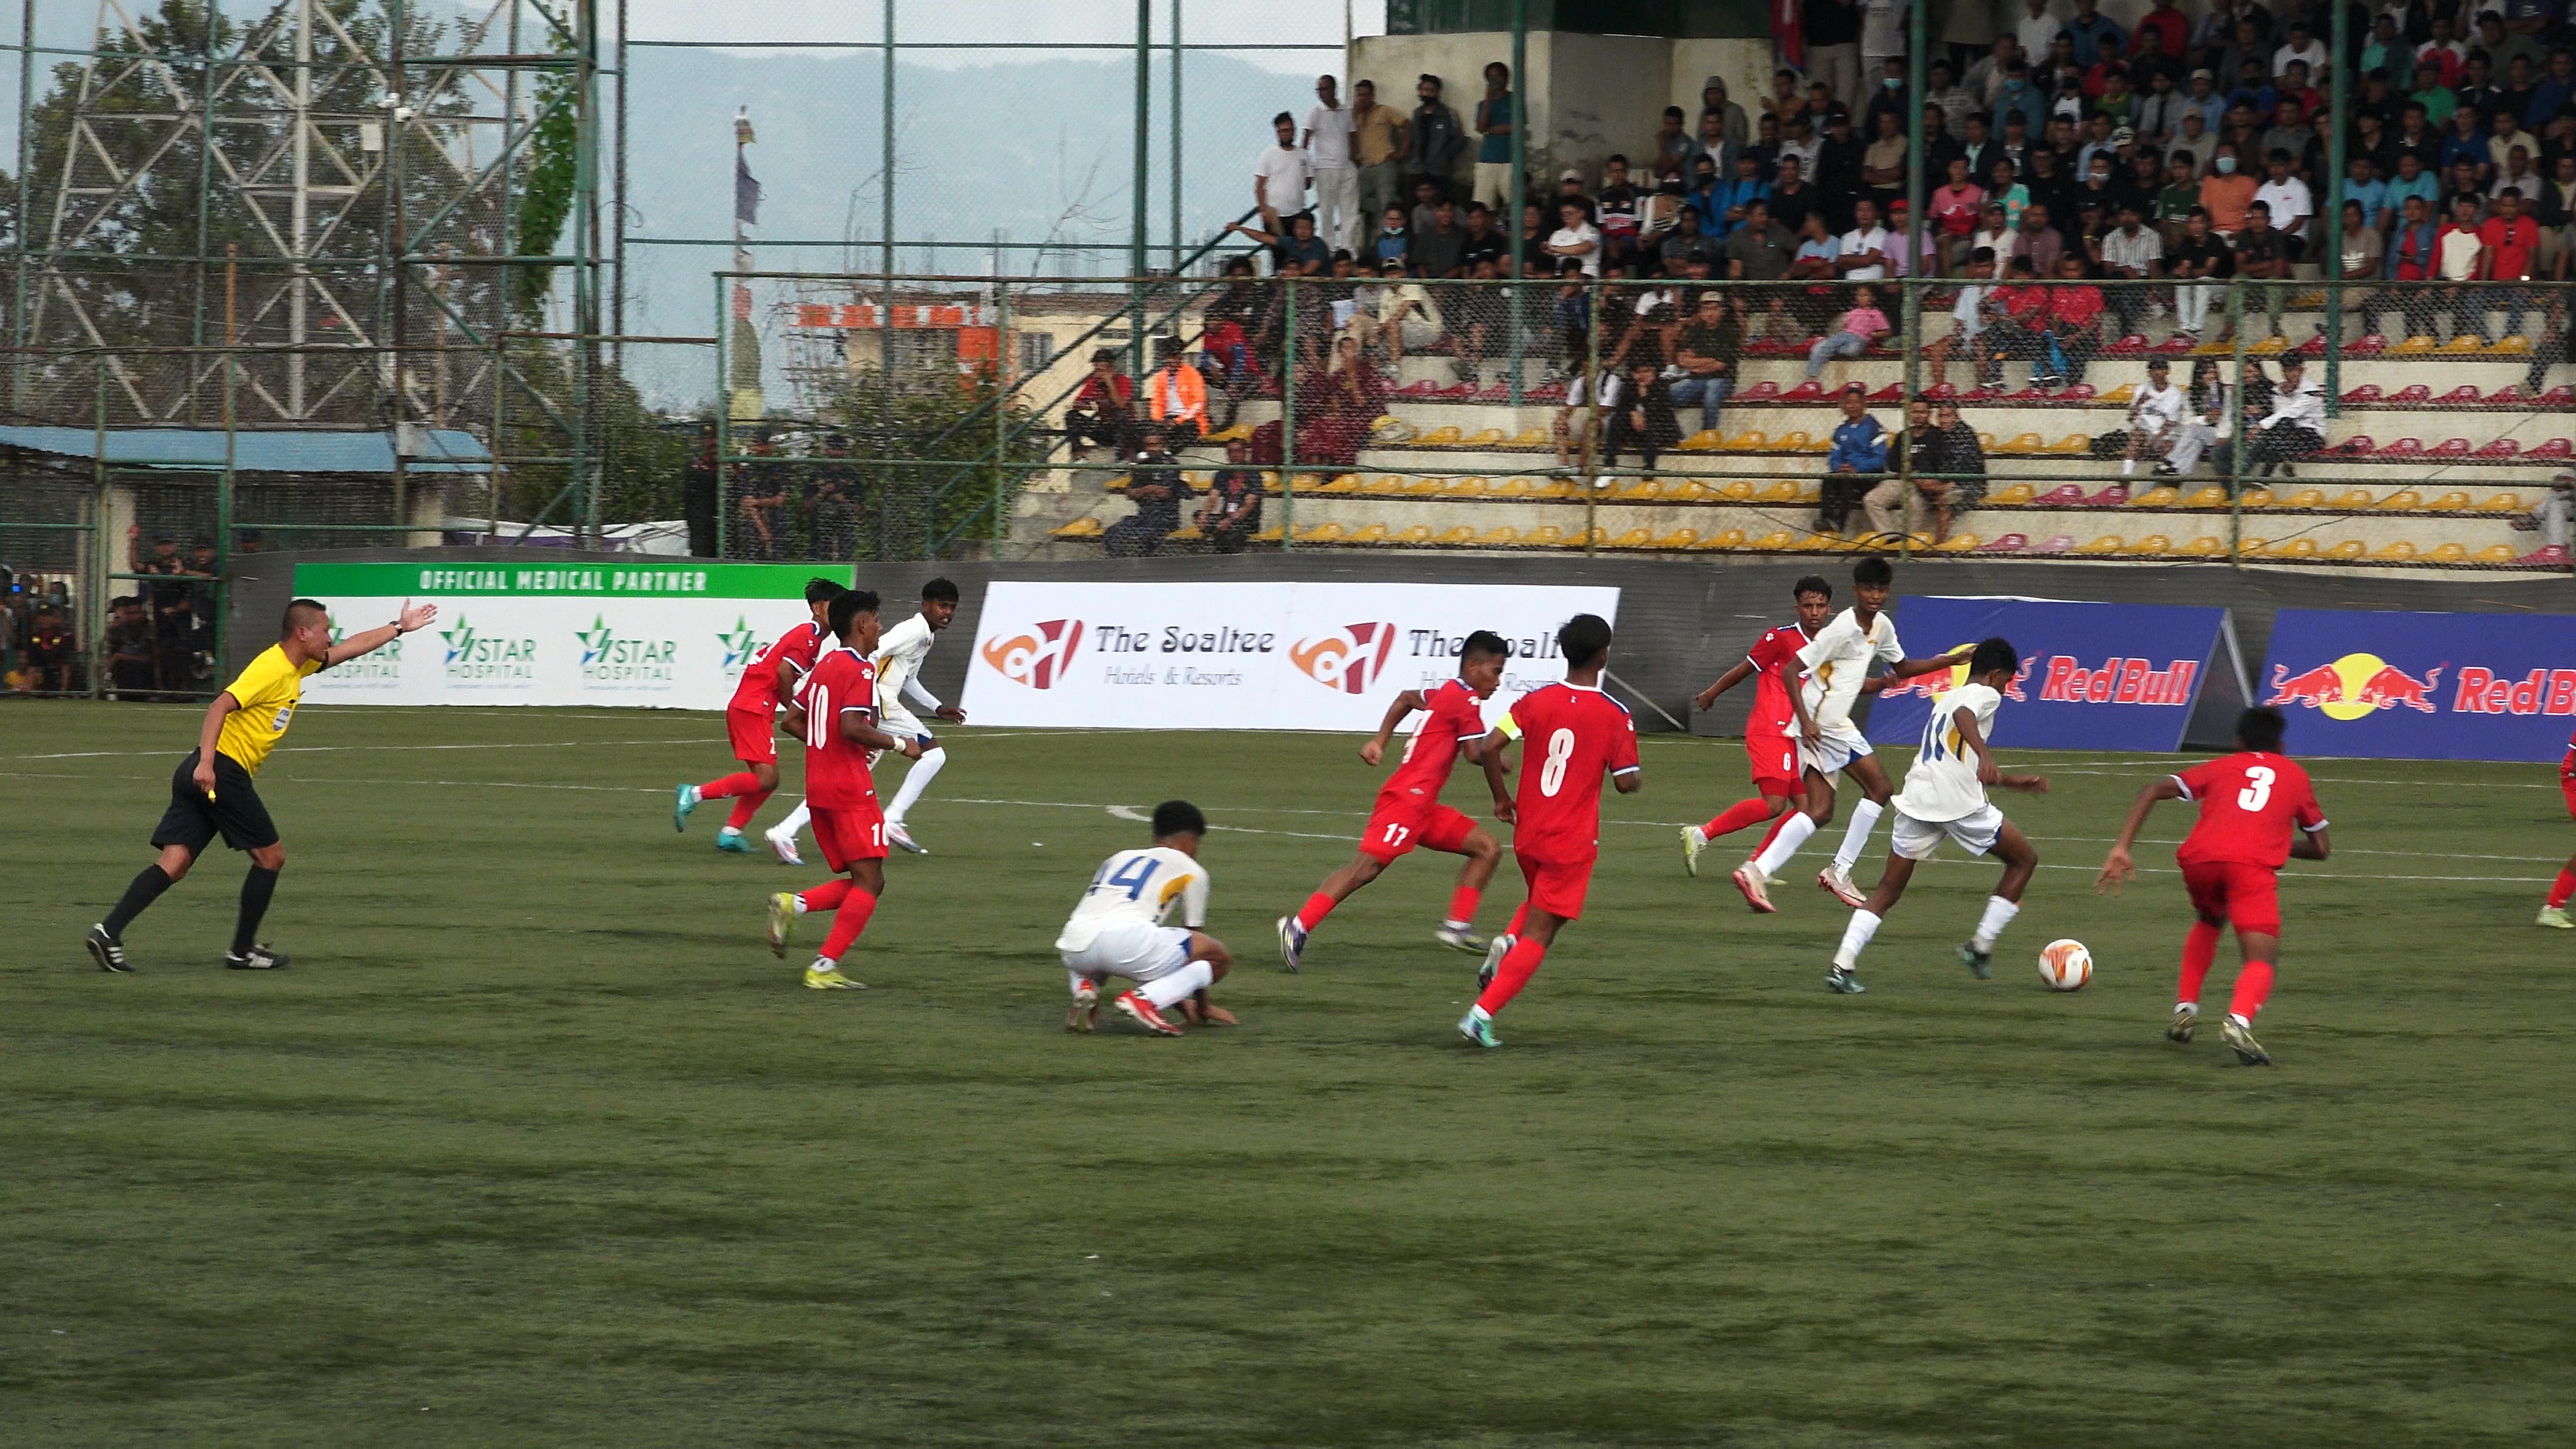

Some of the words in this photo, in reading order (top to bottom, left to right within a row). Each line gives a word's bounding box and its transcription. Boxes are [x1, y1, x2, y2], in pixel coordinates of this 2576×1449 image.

[419, 570, 508, 590] OFFICIAL
[516, 571, 603, 591] MEDICAL
[612, 572, 708, 591] PARTNER
[474, 638, 537, 662] STAR
[612, 639, 678, 663] STAR
[1096, 625, 1149, 653] The
[1161, 625, 1276, 653] Soaltee
[317, 664, 400, 678] OSPITAL
[446, 665, 533, 679] HOSPITAL
[583, 666, 674, 681] HOSPITAL
[1104, 663, 1157, 684] Hotels
[1183, 666, 1242, 686] Resorts
[806, 682, 829, 750] 10
[1540, 728, 1575, 798] 8
[1782, 752, 1792, 771] 6
[2237, 766, 2276, 812] 3
[1383, 822, 1410, 847] 17
